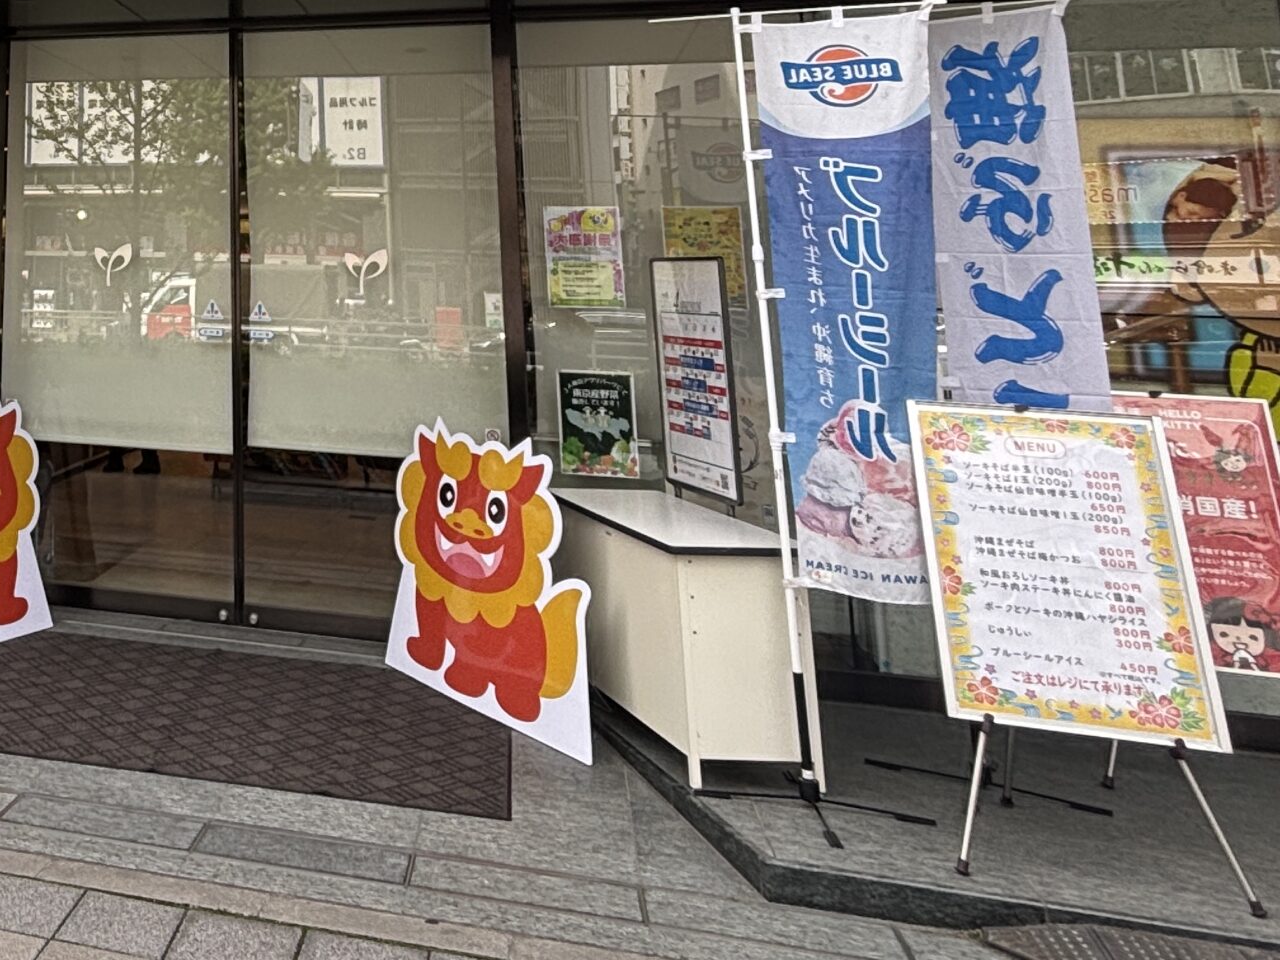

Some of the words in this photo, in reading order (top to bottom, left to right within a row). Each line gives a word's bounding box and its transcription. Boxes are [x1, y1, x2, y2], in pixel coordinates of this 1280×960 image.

[1158, 409, 1202, 419] HELLO
[1163, 420, 1202, 431] KITTY
[1013, 440, 1056, 454] MENU
[1083, 470, 1120, 481] 600円
[1090, 503, 1127, 515] 650円
[991, 647, 1084, 667] ブルーシールアイス
[1011, 670, 1144, 697] ご注文はレジにて承ります
